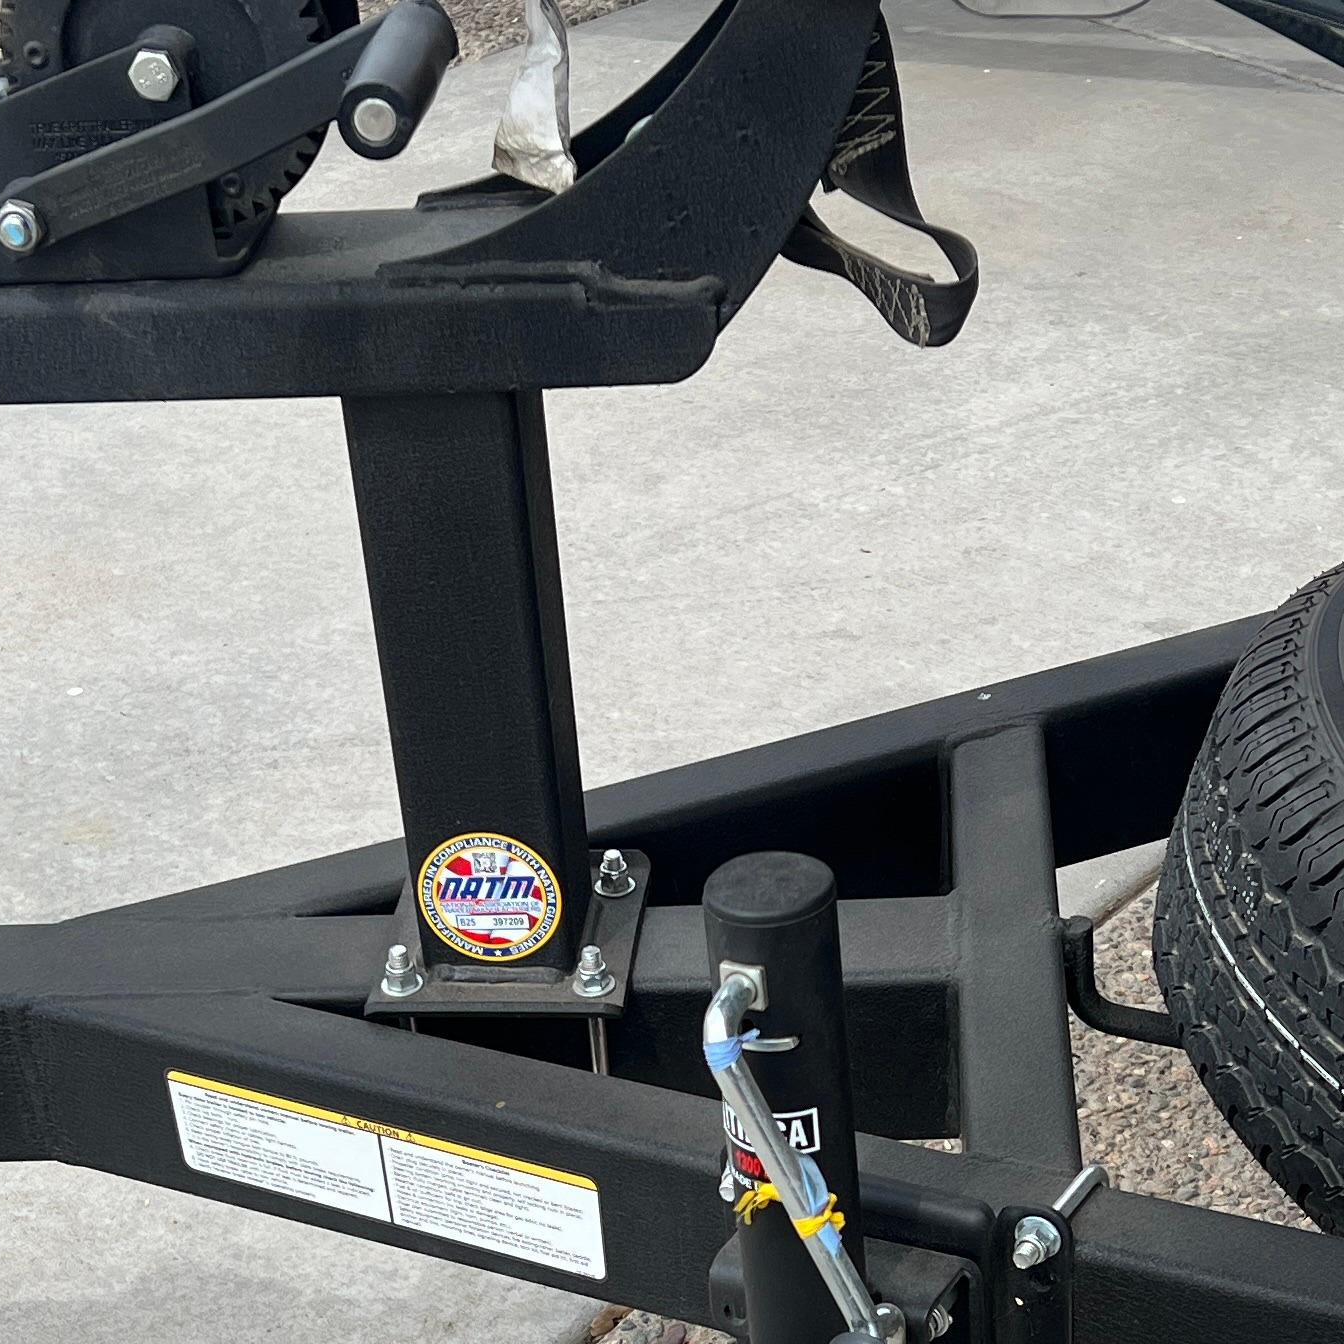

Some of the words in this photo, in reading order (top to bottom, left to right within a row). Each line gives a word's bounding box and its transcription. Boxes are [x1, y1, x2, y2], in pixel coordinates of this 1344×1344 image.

[434, 838, 509, 866] COMPLIANCE
[511, 841, 540, 869] WITH
[427, 866, 437, 879] IN
[537, 869, 556, 902] NATM
[439, 876, 536, 900] NATM
[422, 880, 484, 955] MANUFACTURED
[493, 917, 525, 927] 397209
[509, 906, 556, 955] GUIDELINES
[356, 1120, 400, 1138] CAUTION
